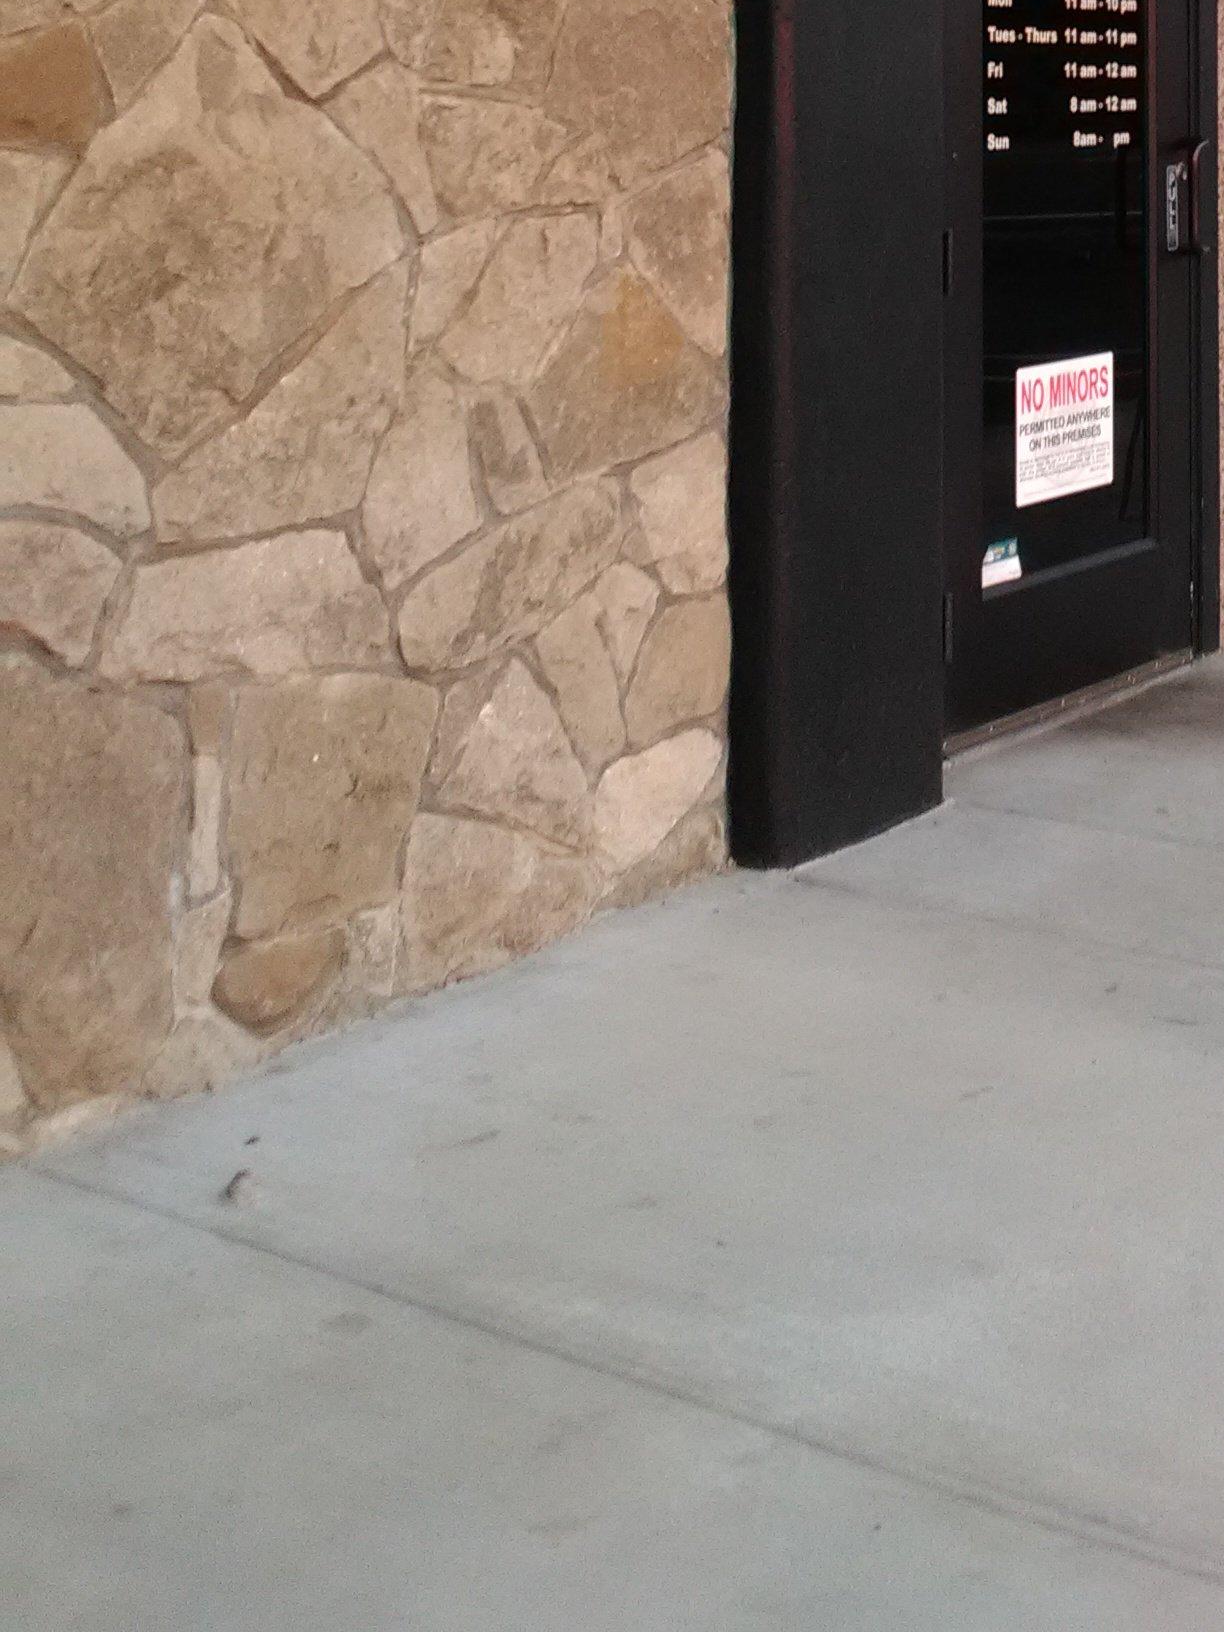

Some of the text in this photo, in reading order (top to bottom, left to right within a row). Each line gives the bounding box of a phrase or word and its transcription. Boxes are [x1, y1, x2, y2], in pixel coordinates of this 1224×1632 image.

[987, 25, 1016, 43] Tues
[1024, 26, 1058, 44] Thurs
[1064, 27, 1077, 44] 11
[1080, 31, 1097, 45] am
[1106, 28, 1118, 45] 11
[1120, 32, 1137, 48] pm
[987, 61, 1003, 79] Fri
[1064, 62, 1077, 78] 11
[1080, 65, 1097, 78] am
[1106, 61, 1118, 78] 12
[1120, 65, 1137, 78] am
[987, 96, 1008, 115] Sat
[1070, 96, 1078, 113] 8
[1080, 99, 1097, 113] am
[1106, 95, 1118, 112] 12
[1120, 98, 1137, 112] am
[987, 132, 1010, 151] Sun
[1113, 132, 1130, 149] pm
[1021, 365, 1108, 415] NO MINORS
[1019, 405, 1111, 437] PERMITTED ANYWHERE
[1028, 424, 1101, 452] ON THIS PREMISES
